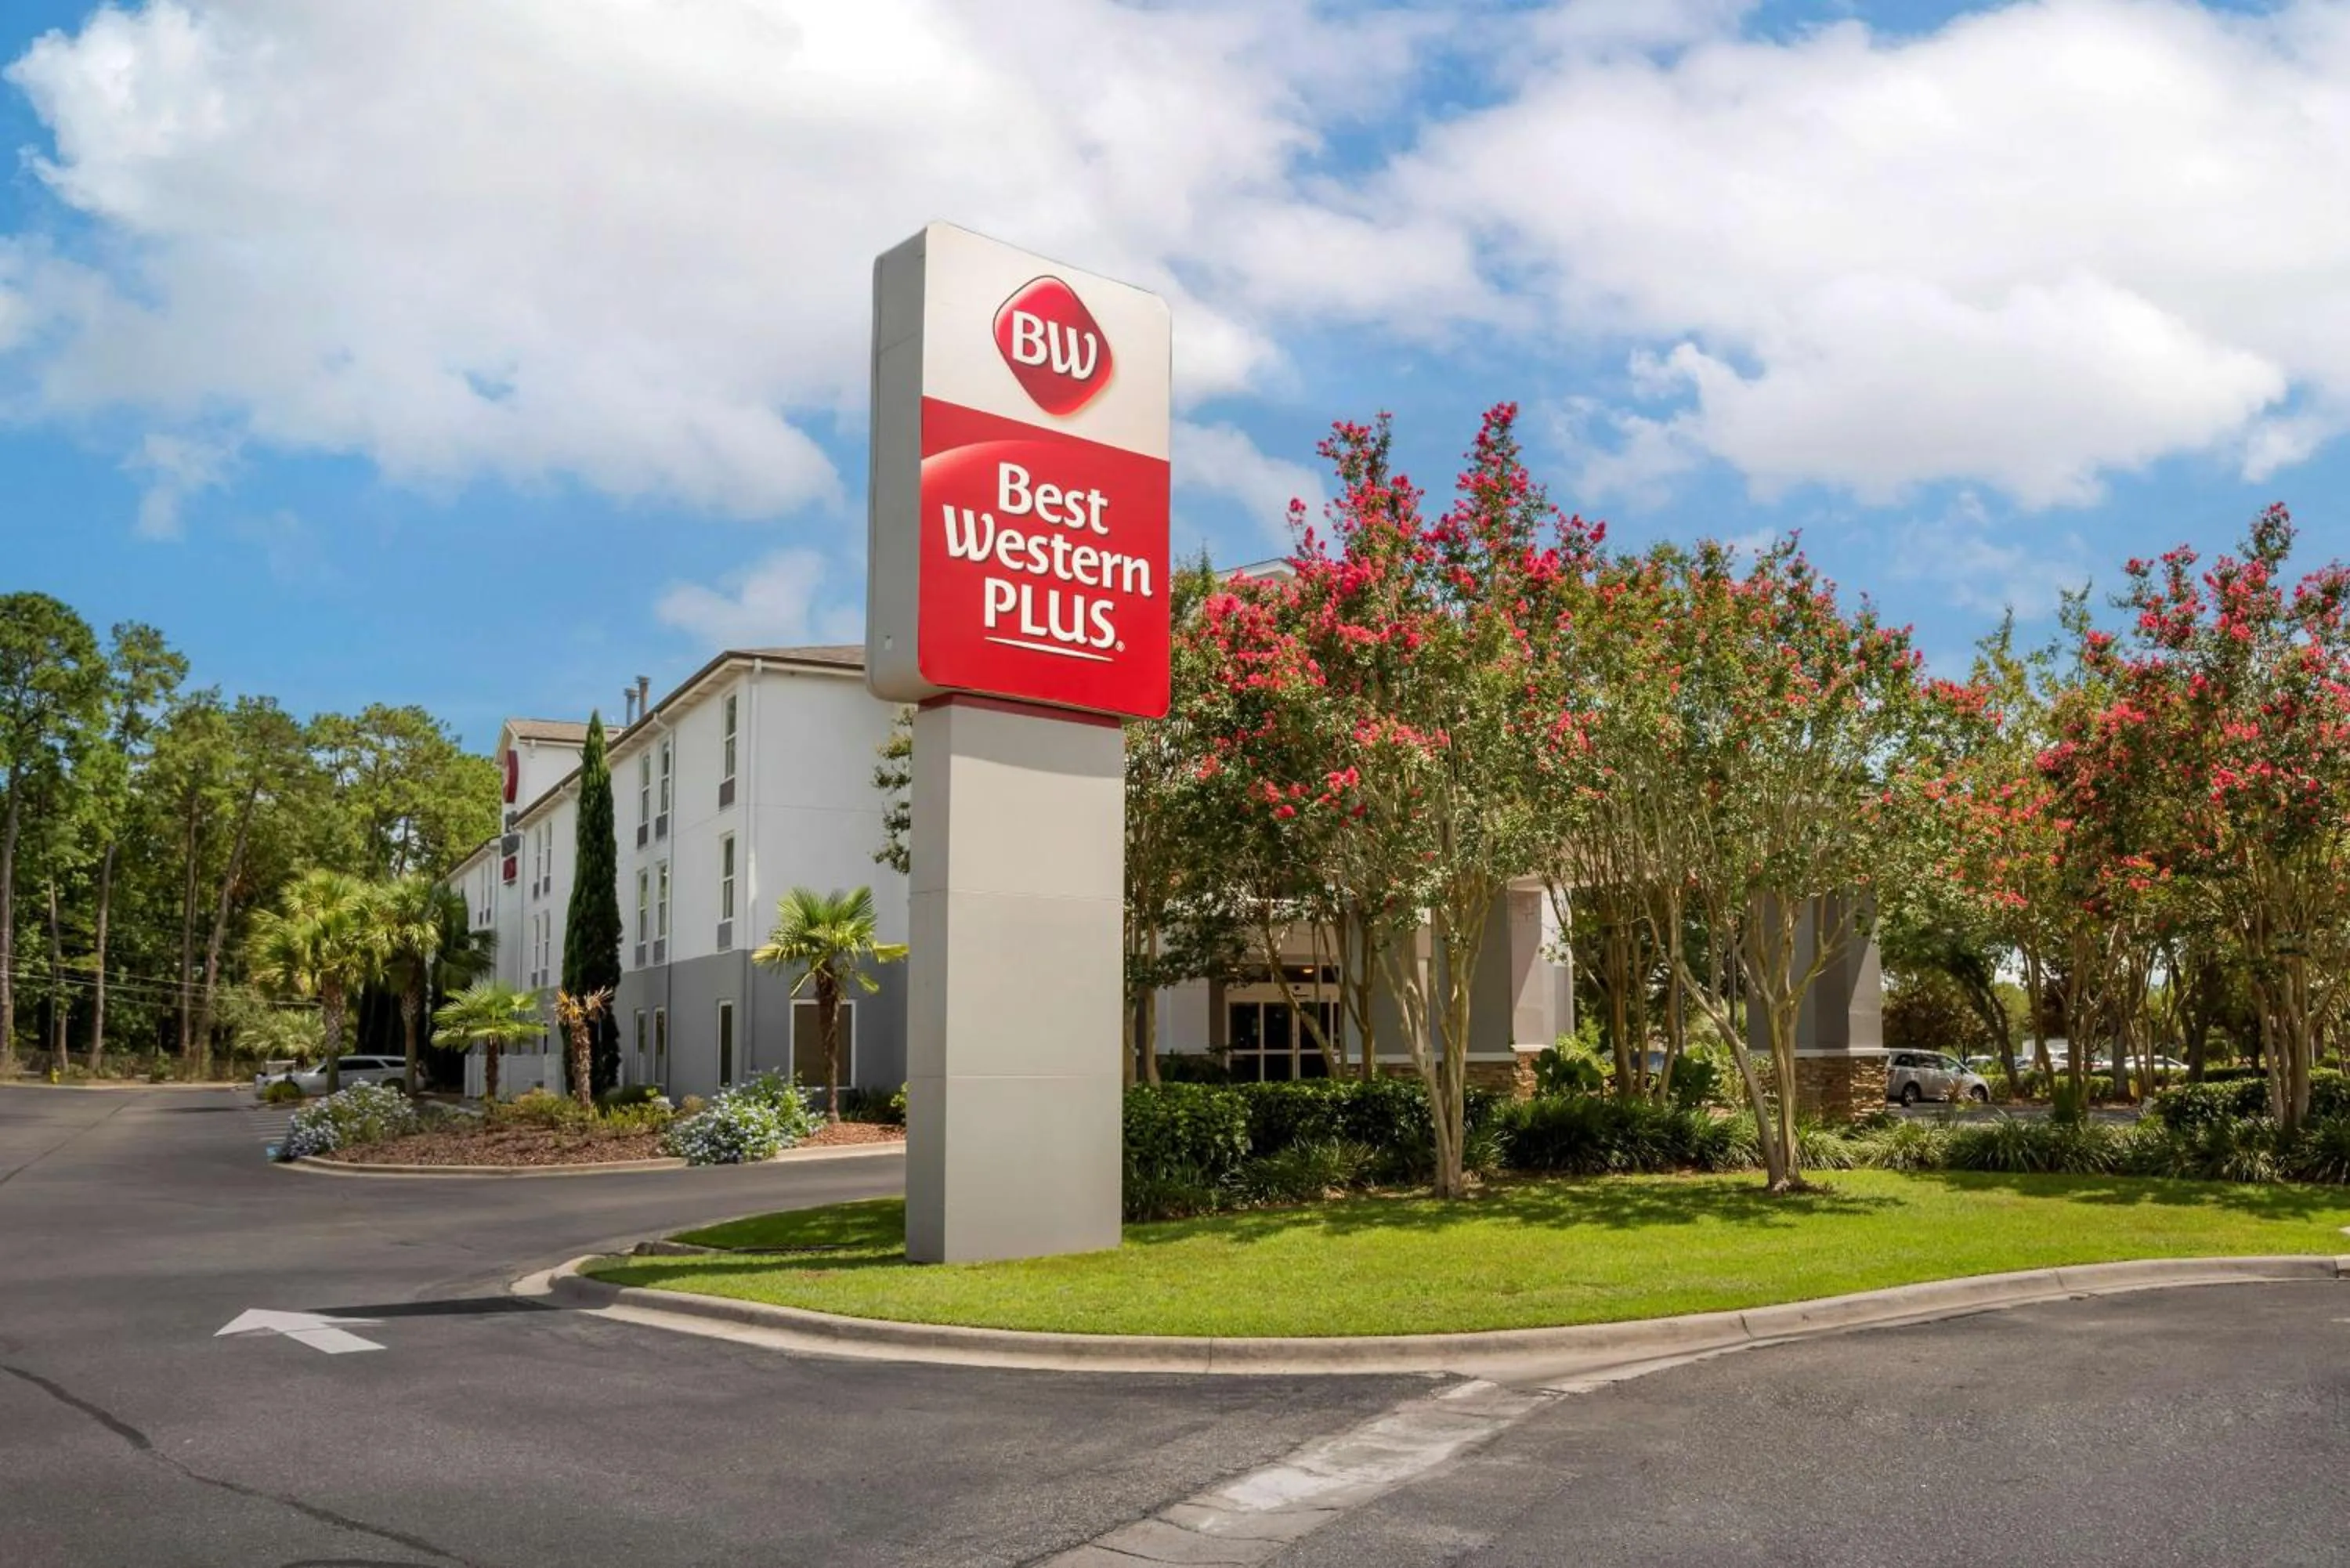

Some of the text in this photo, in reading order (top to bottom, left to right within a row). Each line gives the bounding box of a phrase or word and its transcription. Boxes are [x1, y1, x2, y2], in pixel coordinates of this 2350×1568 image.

[1011, 310, 1097, 380] BW
[998, 462, 1108, 535] Best
[942, 504, 1152, 597] Western
[985, 577, 1115, 649] PLUS
